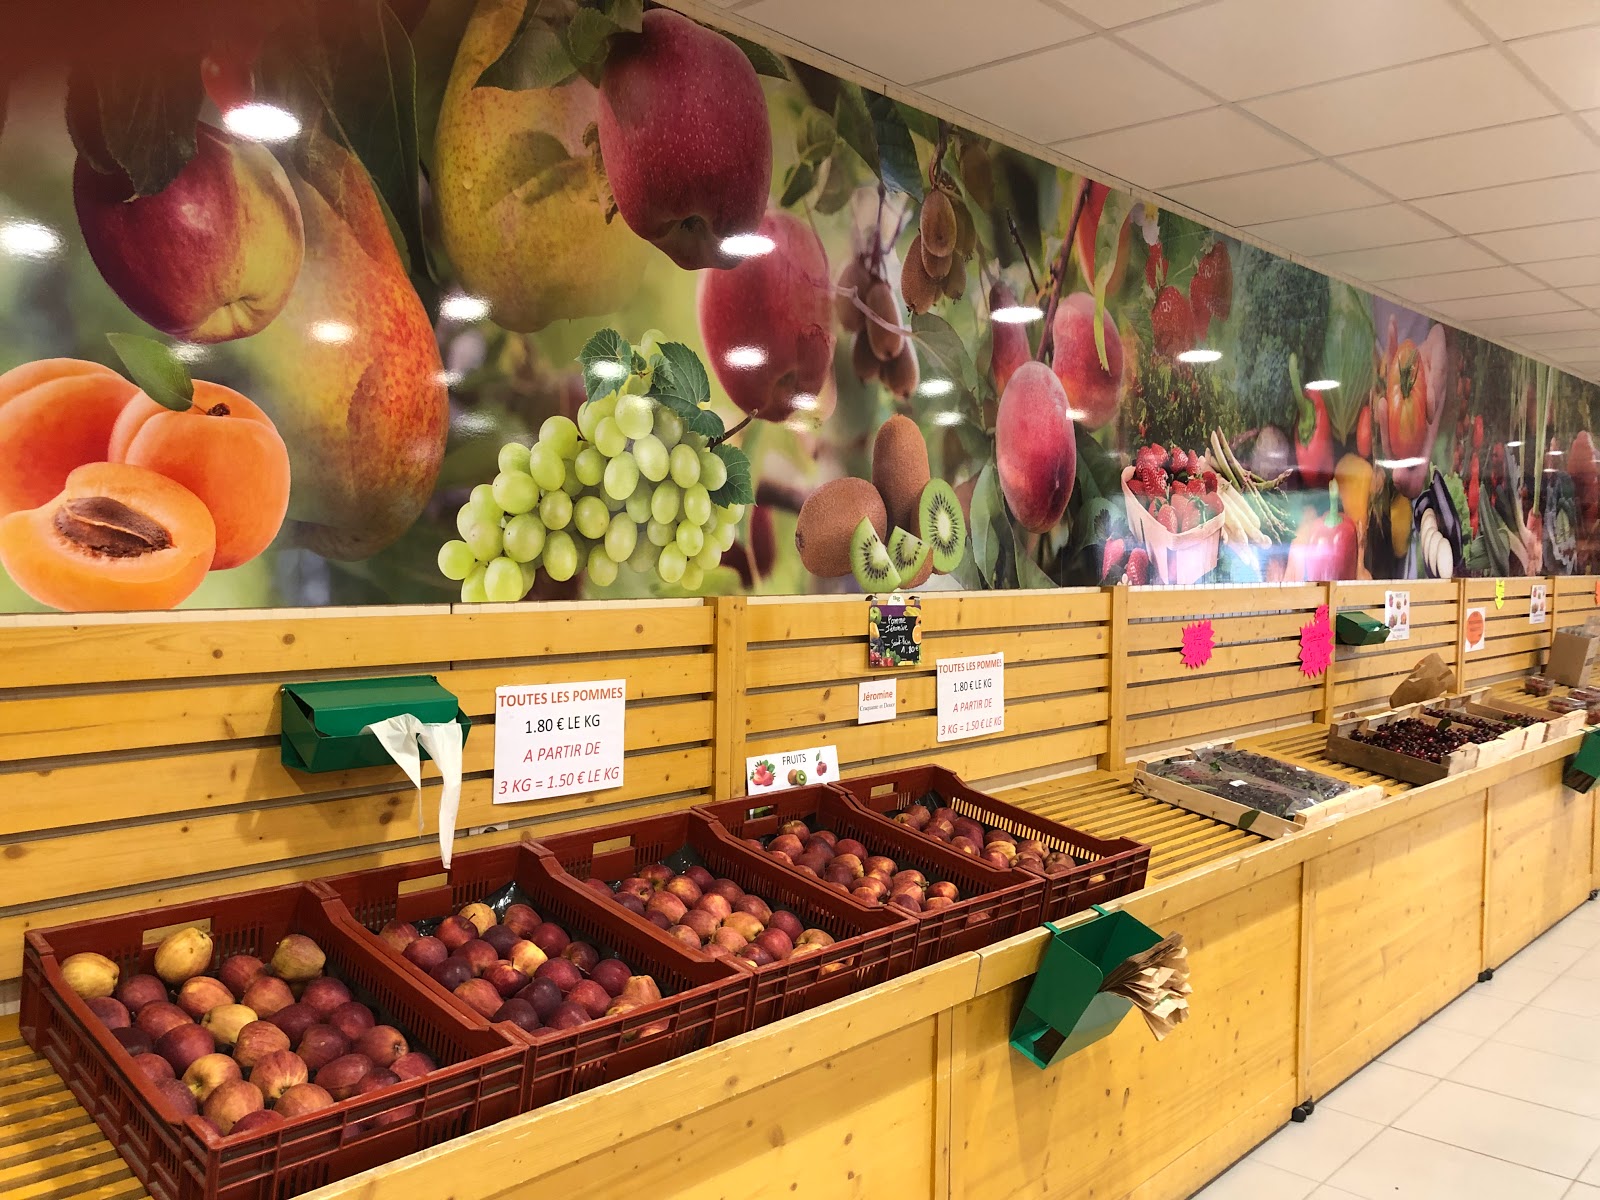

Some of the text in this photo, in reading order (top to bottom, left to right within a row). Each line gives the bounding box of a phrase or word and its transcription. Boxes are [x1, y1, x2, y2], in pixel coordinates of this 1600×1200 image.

[939, 663, 965, 673] TOUTES
[966, 662, 976, 671] LES
[954, 678, 992, 693] 1.80 € LE KG
[499, 687, 623, 707] TOUTES LES POMMES
[863, 690, 893, 701] Jéromine
[953, 698, 993, 713] A PARTIR DE
[525, 714, 600, 734] 1.80 € LE KG
[940, 725, 946, 736] 3
[948, 724, 958, 734] KG
[966, 720, 980, 732] 1.50
[980, 718, 985, 728] €
[986, 718, 993, 728] LE
[994, 716, 1002, 727] KG
[523, 741, 601, 763] A PARTIR DE
[782, 754, 806, 765] FRUITS
[498, 780, 508, 794] 3
[512, 778, 532, 793] KG
[547, 772, 574, 789] 1.50
[577, 771, 585, 784] €
[588, 768, 601, 783] LE
[603, 766, 620, 781] KG
